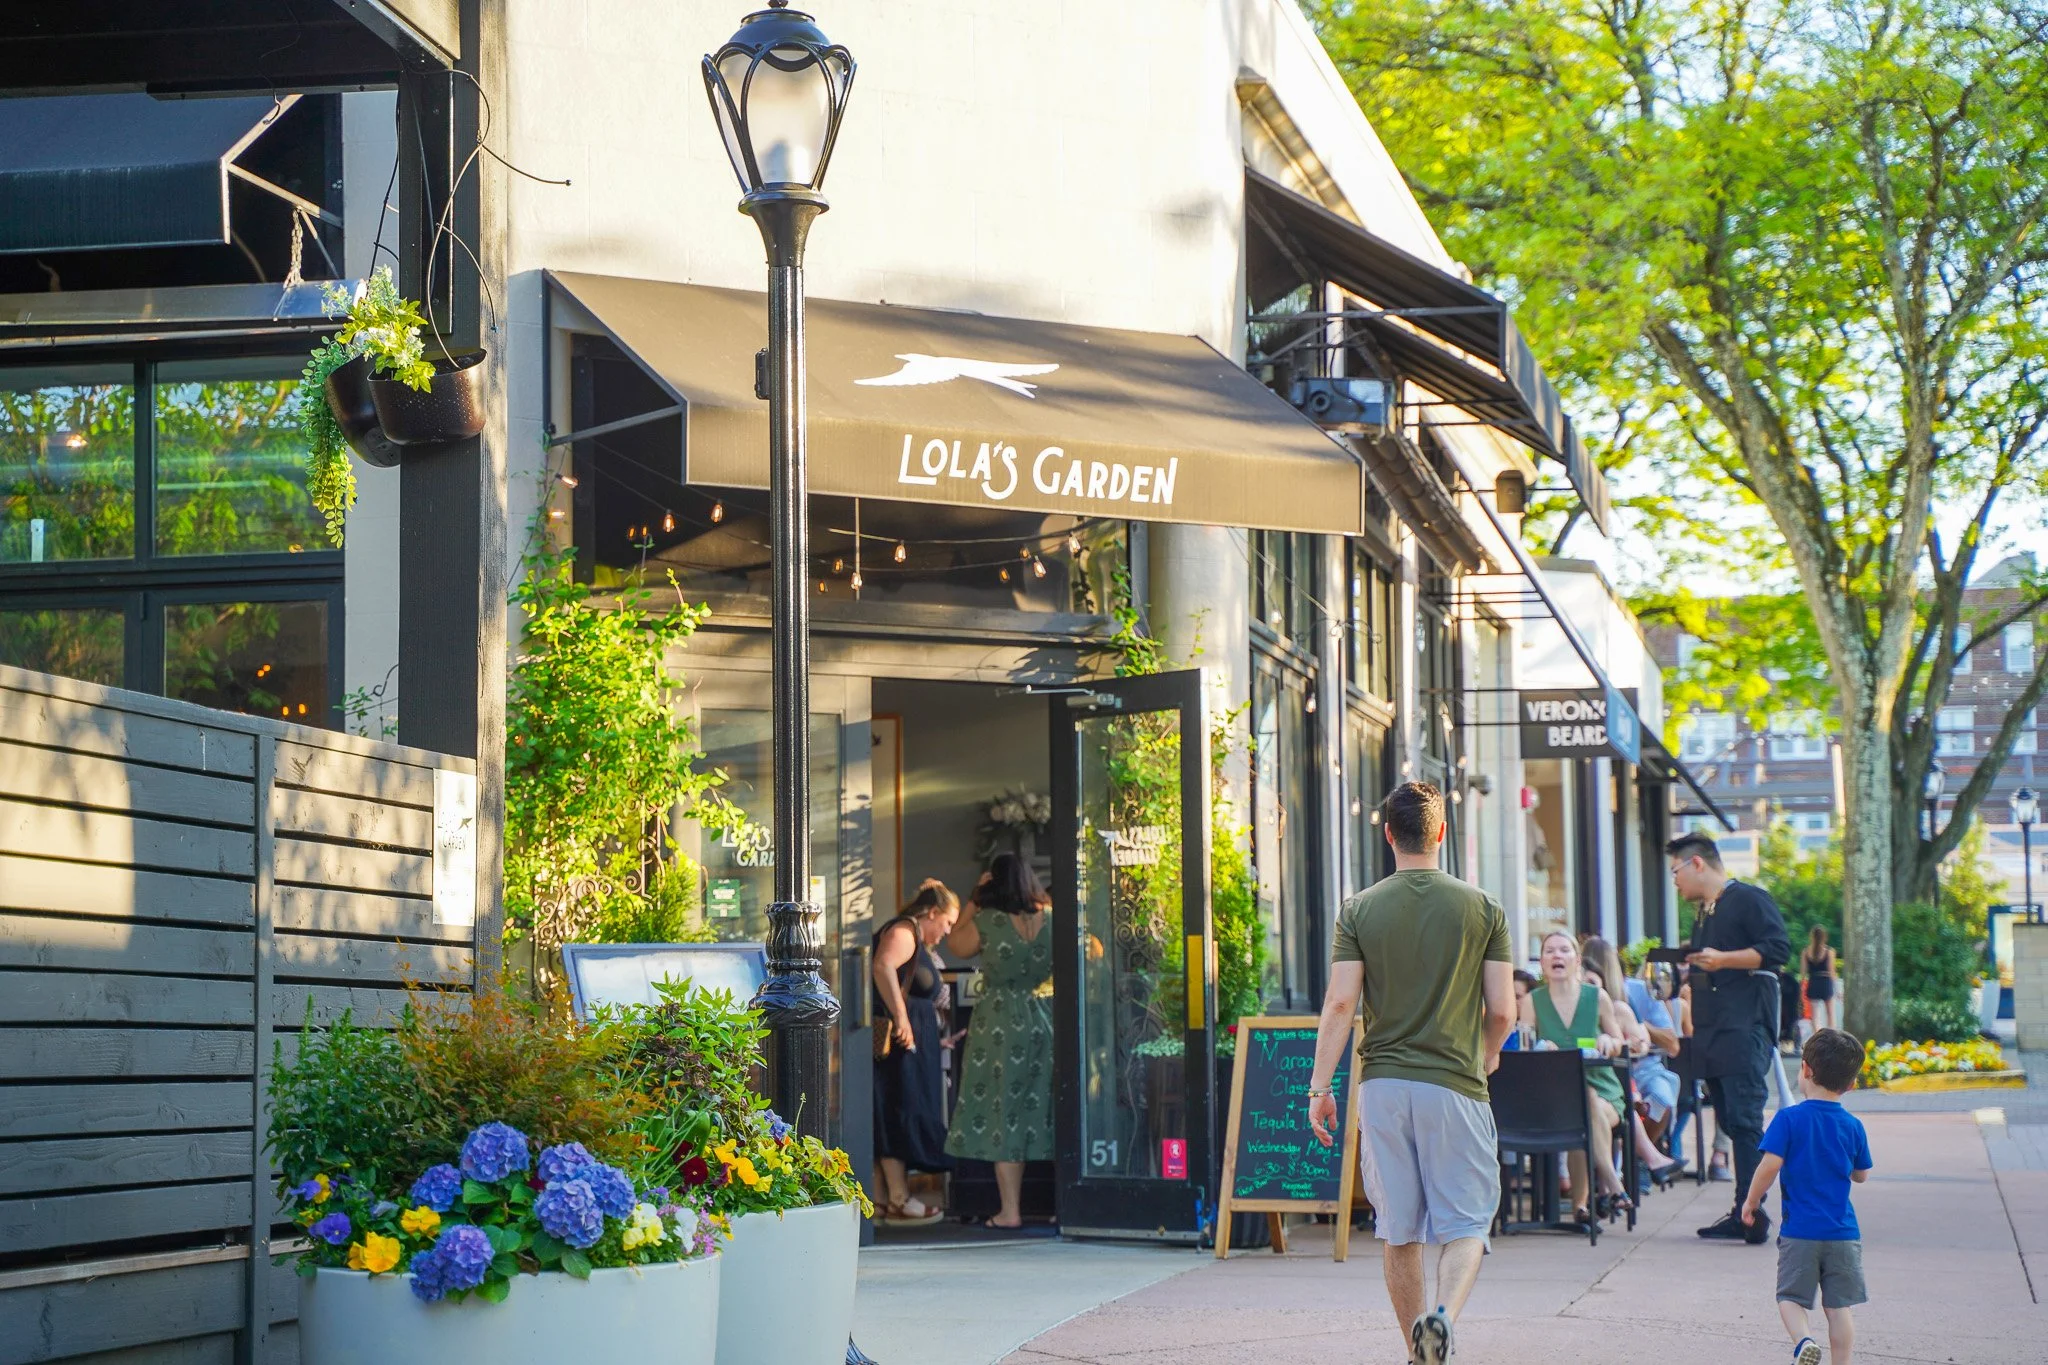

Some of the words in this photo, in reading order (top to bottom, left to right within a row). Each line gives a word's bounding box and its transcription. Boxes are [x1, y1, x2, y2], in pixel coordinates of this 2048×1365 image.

[898, 434, 1018, 500] LOLA'S
[1033, 447, 1178, 504] GARDEN
[1090, 1140, 1118, 1166] 51
